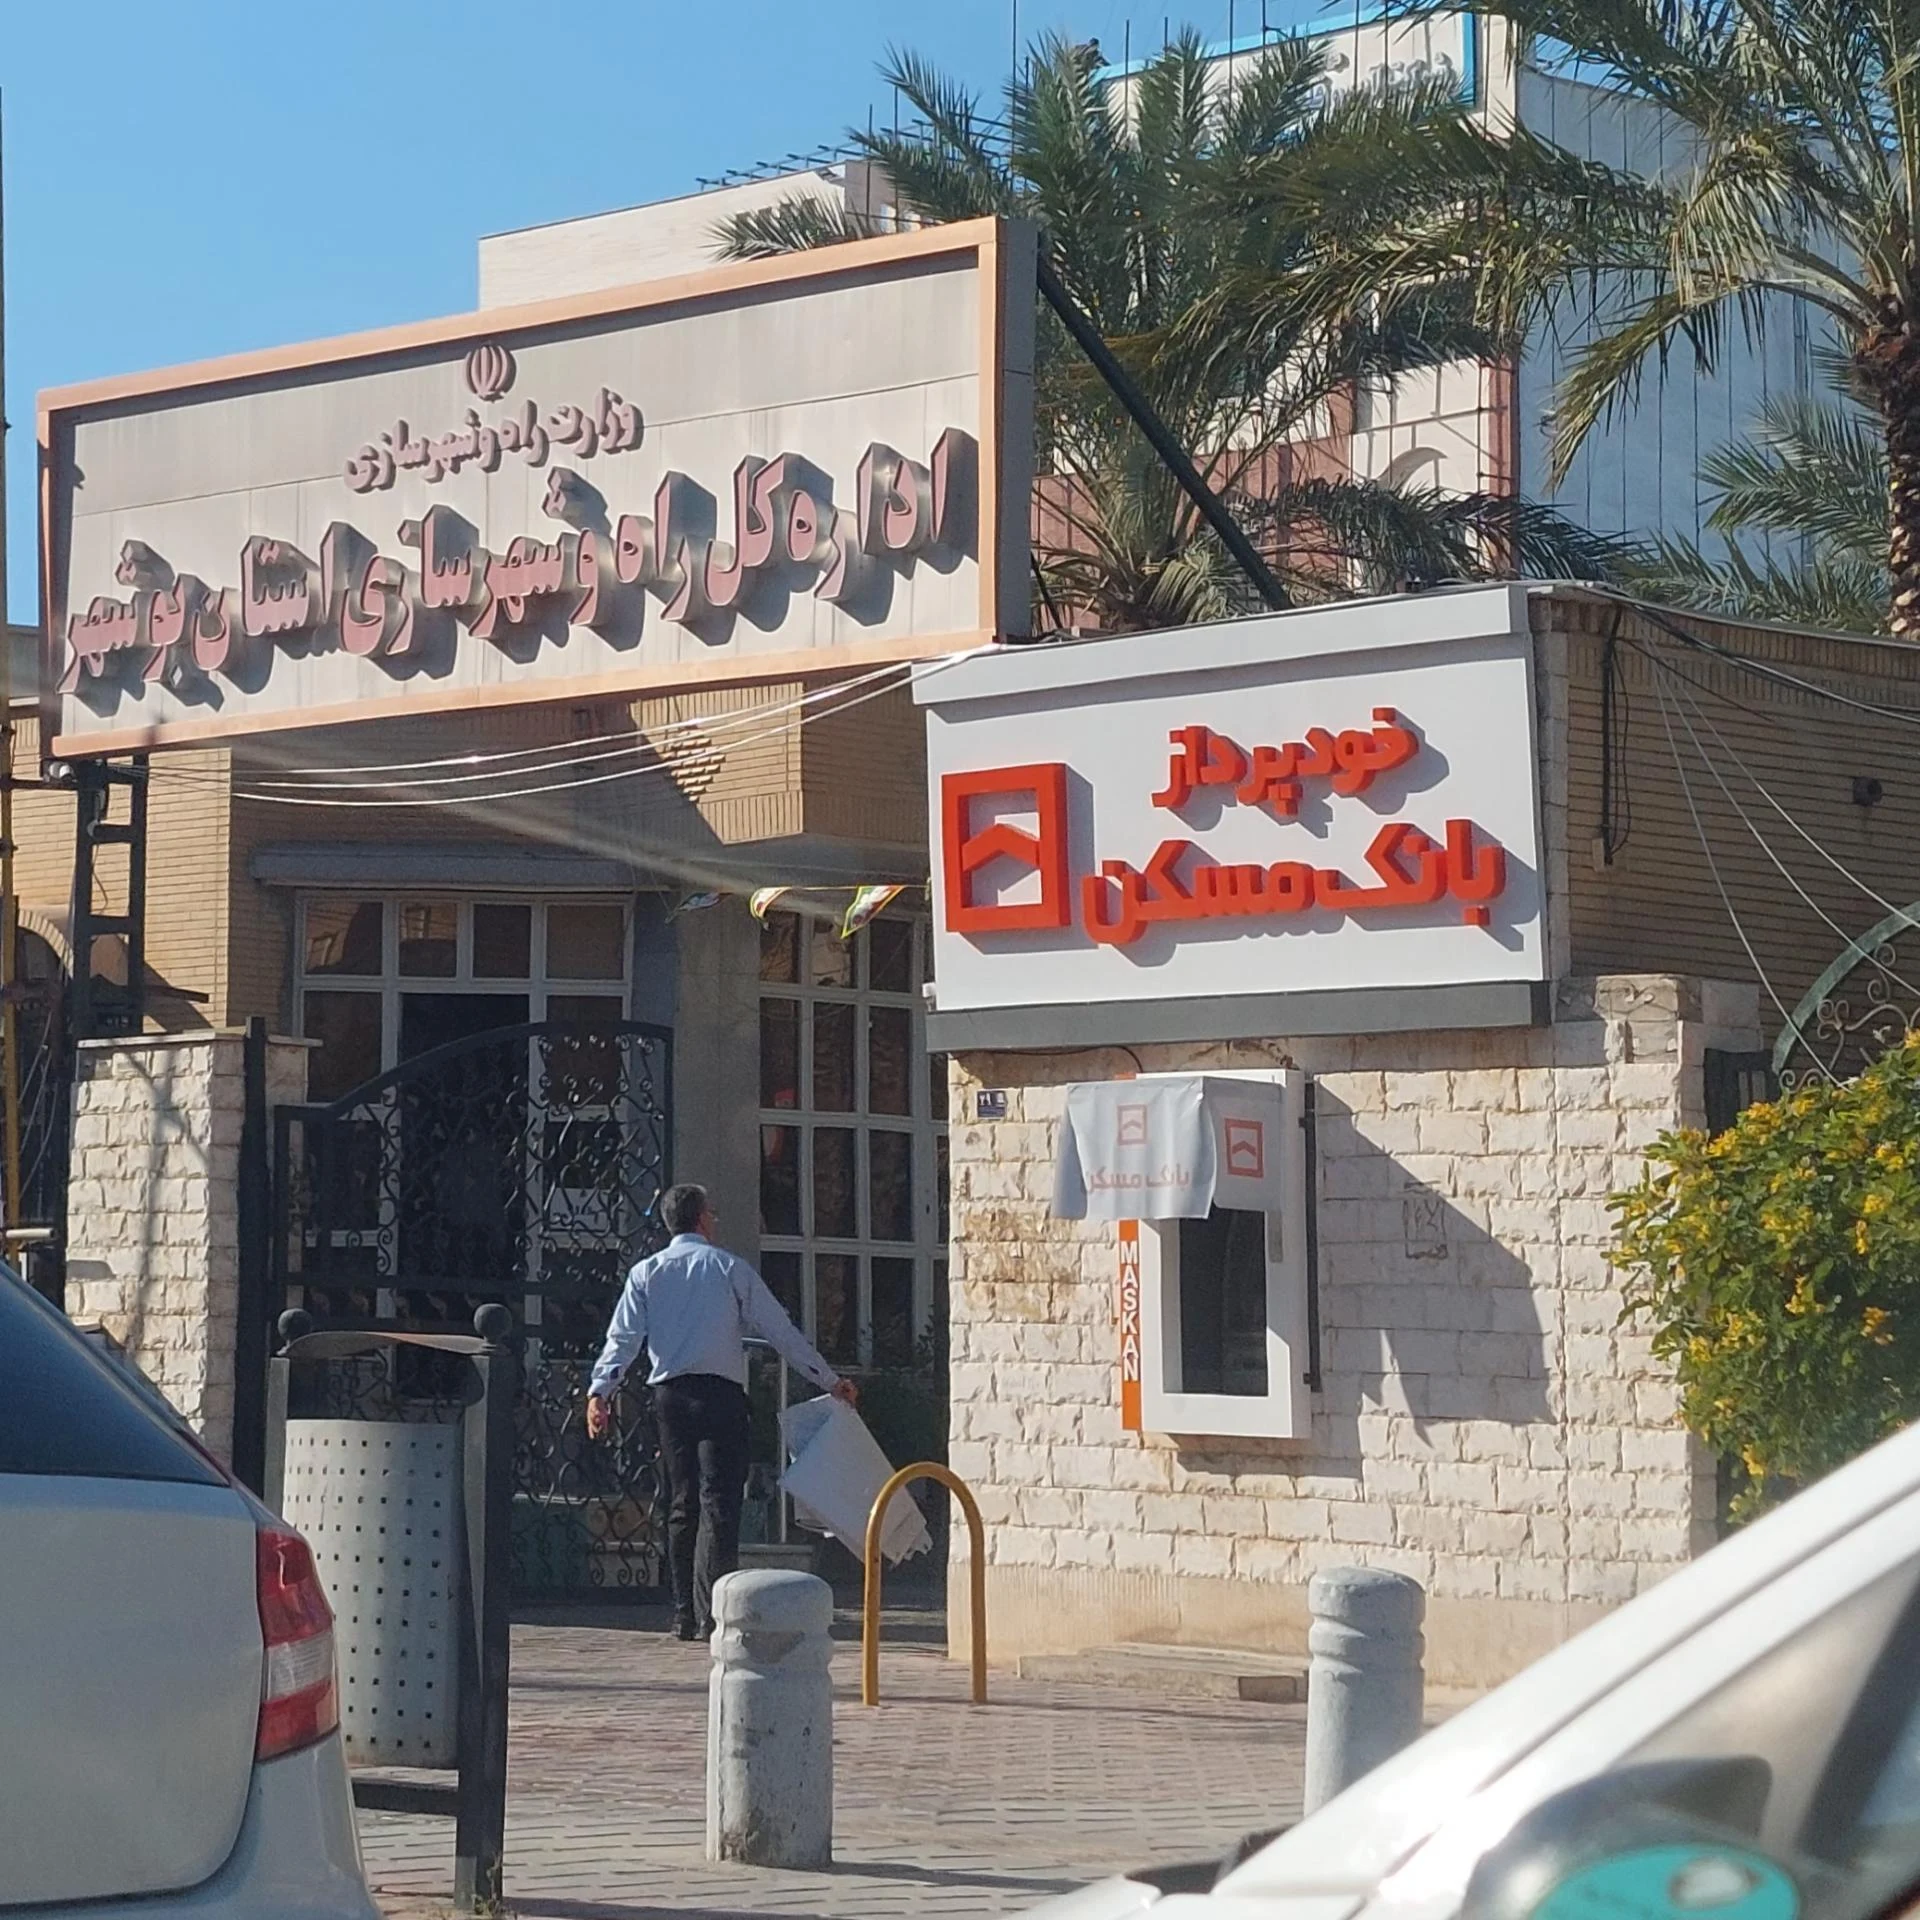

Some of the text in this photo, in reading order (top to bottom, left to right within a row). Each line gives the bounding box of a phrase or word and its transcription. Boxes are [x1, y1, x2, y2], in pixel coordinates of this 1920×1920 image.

[344, 408, 481, 493] شهرسازی
[500, 400, 549, 467] راه
[549, 387, 642, 459] وزارت
[338, 466, 568, 657] شهرسازی
[614, 472, 692, 622] راه
[704, 456, 785, 607] کل
[787, 428, 952, 601] اداره
[56, 539, 185, 694] بوشهر
[191, 521, 337, 672] استان
[1152, 707, 1418, 817] خودپرداز
[1082, 819, 1506, 944] بانک مسکن
[1145, 1163, 1190, 1190] بانک
[1120, 1240, 1139, 1382] MASKAN
